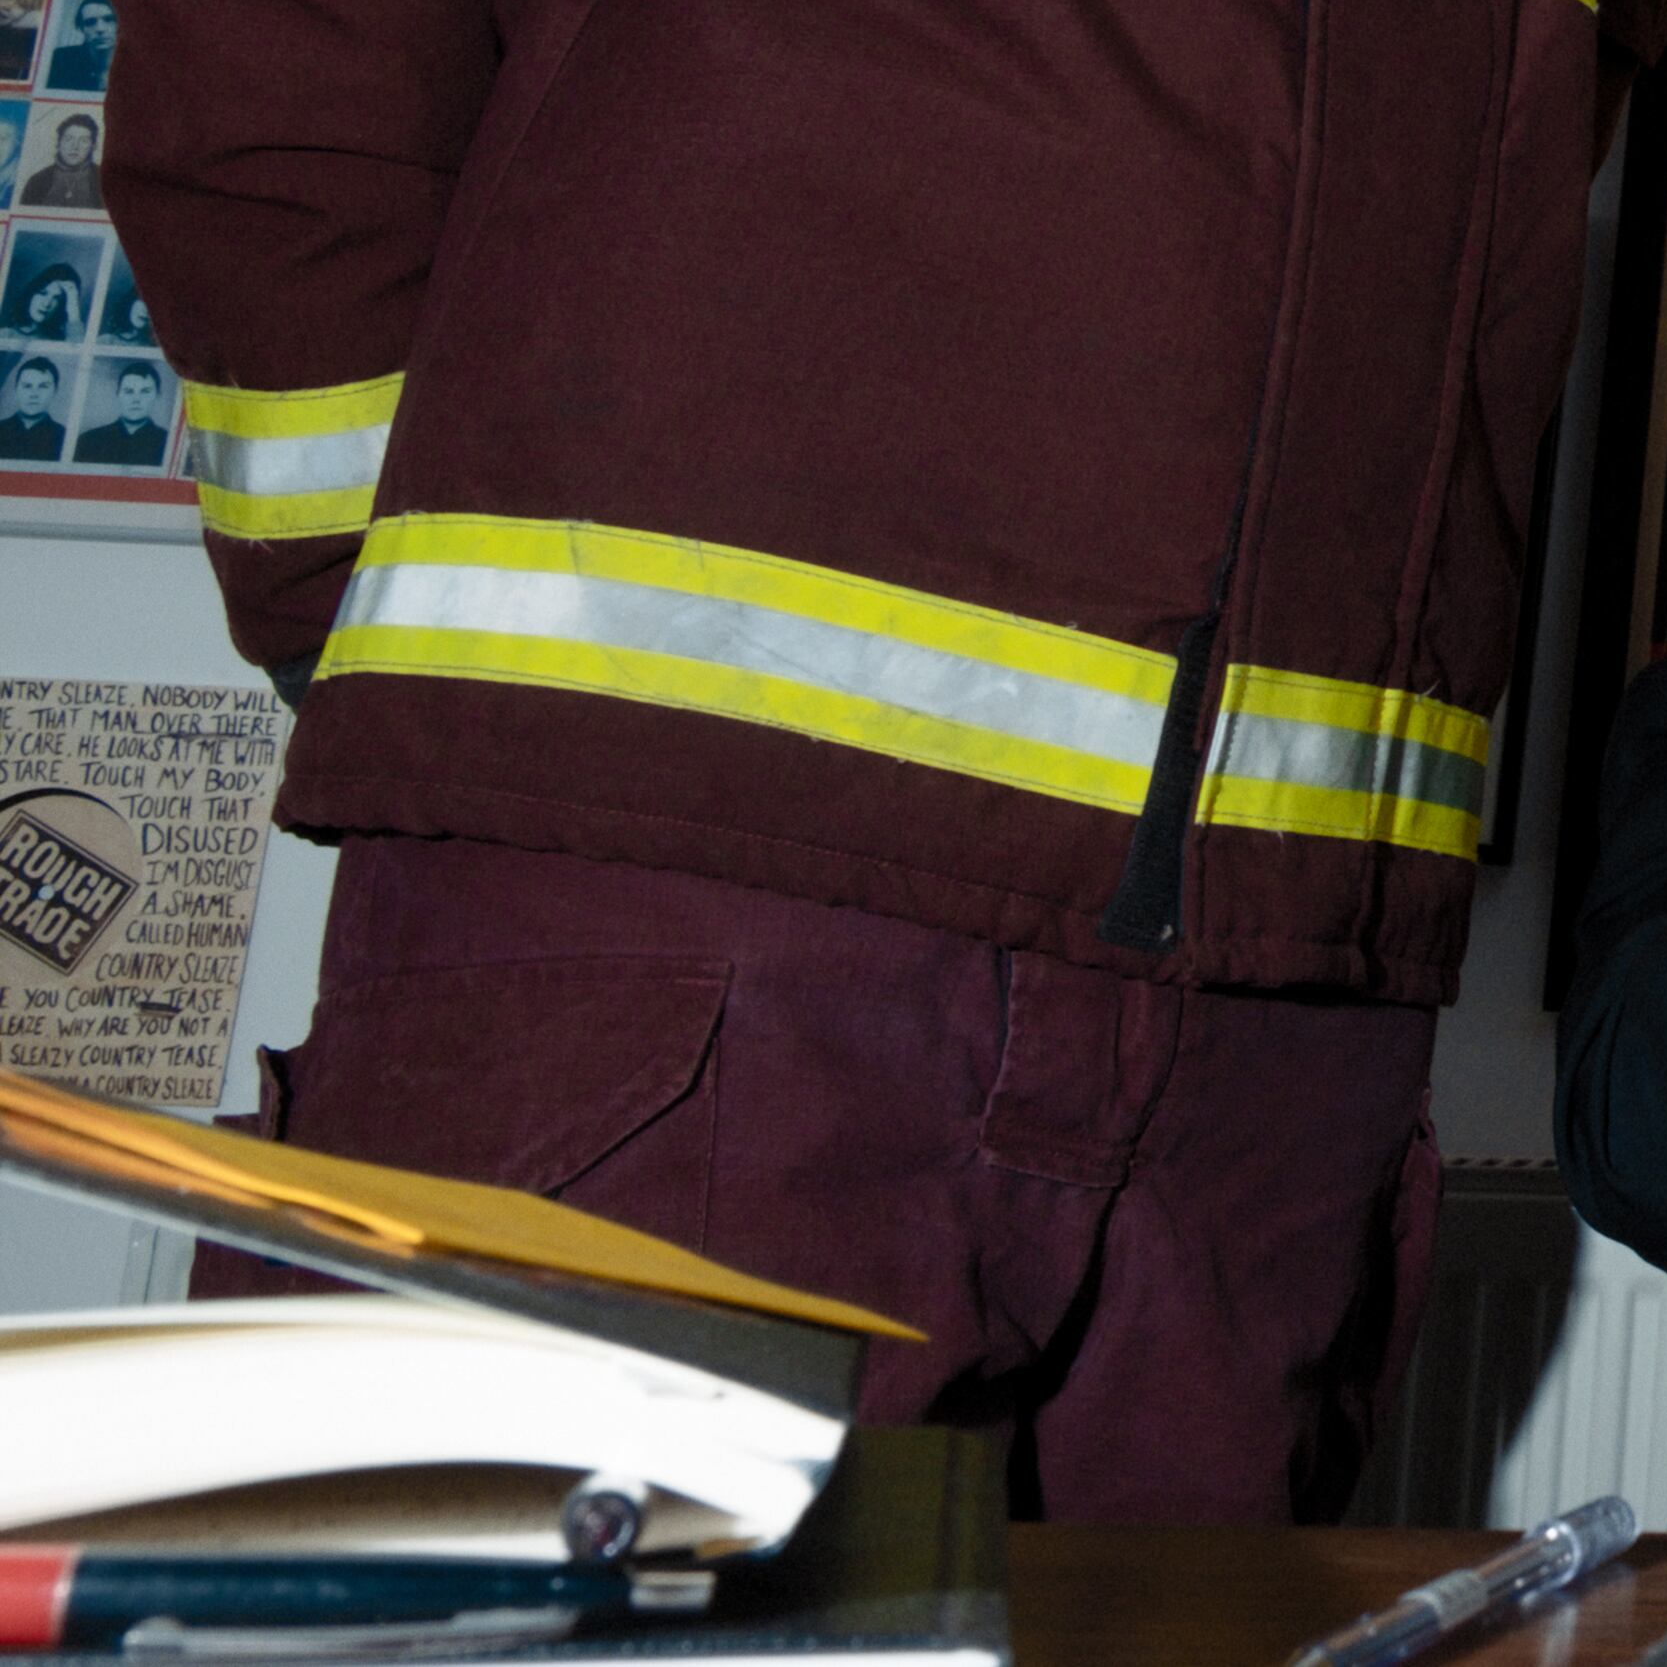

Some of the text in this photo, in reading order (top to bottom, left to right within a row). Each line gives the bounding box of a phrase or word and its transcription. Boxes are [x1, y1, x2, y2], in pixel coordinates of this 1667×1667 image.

[142, 684, 228, 710] NOBODY
[233, 690, 282, 713] WILL
[28, 707, 83, 729] THAT
[90, 709, 138, 733] MAN
[150, 711, 202, 735] OVER
[210, 713, 277, 736] THERE
[78, 735, 101, 757] HE
[107, 735, 161, 761] LOOKS
[167, 735, 195, 762] AT
[197, 738, 229, 765] ME
[234, 738, 276, 766] WITH
[79, 761, 146, 788] TOUCH
[157, 766, 195, 790] MY
[119, 794, 254, 821] TOUCH THAT
[142, 822, 259, 856] DISUSED
[1, 824, 124, 921] ROUGH
[141, 891, 158, 915] A
[125, 920, 249, 948] CALLED HUMAN
[95, 952, 179, 983] COUNTRY
[24, 987, 59, 1010] YOU
[65, 984, 155, 1013] COUNTRY
[57, 1016, 96, 1038] WHY
[96, 1015, 128, 1036] ARE
[136, 1015, 176, 1037] YOU
[178, 1016, 211, 1037] NOT
[218, 1016, 229, 1038] A
[9, 1042, 76, 1068] SLEAZY
[80, 1044, 157, 1069] COUNTRY
[96, 1074, 160, 1099] COUNTRY
